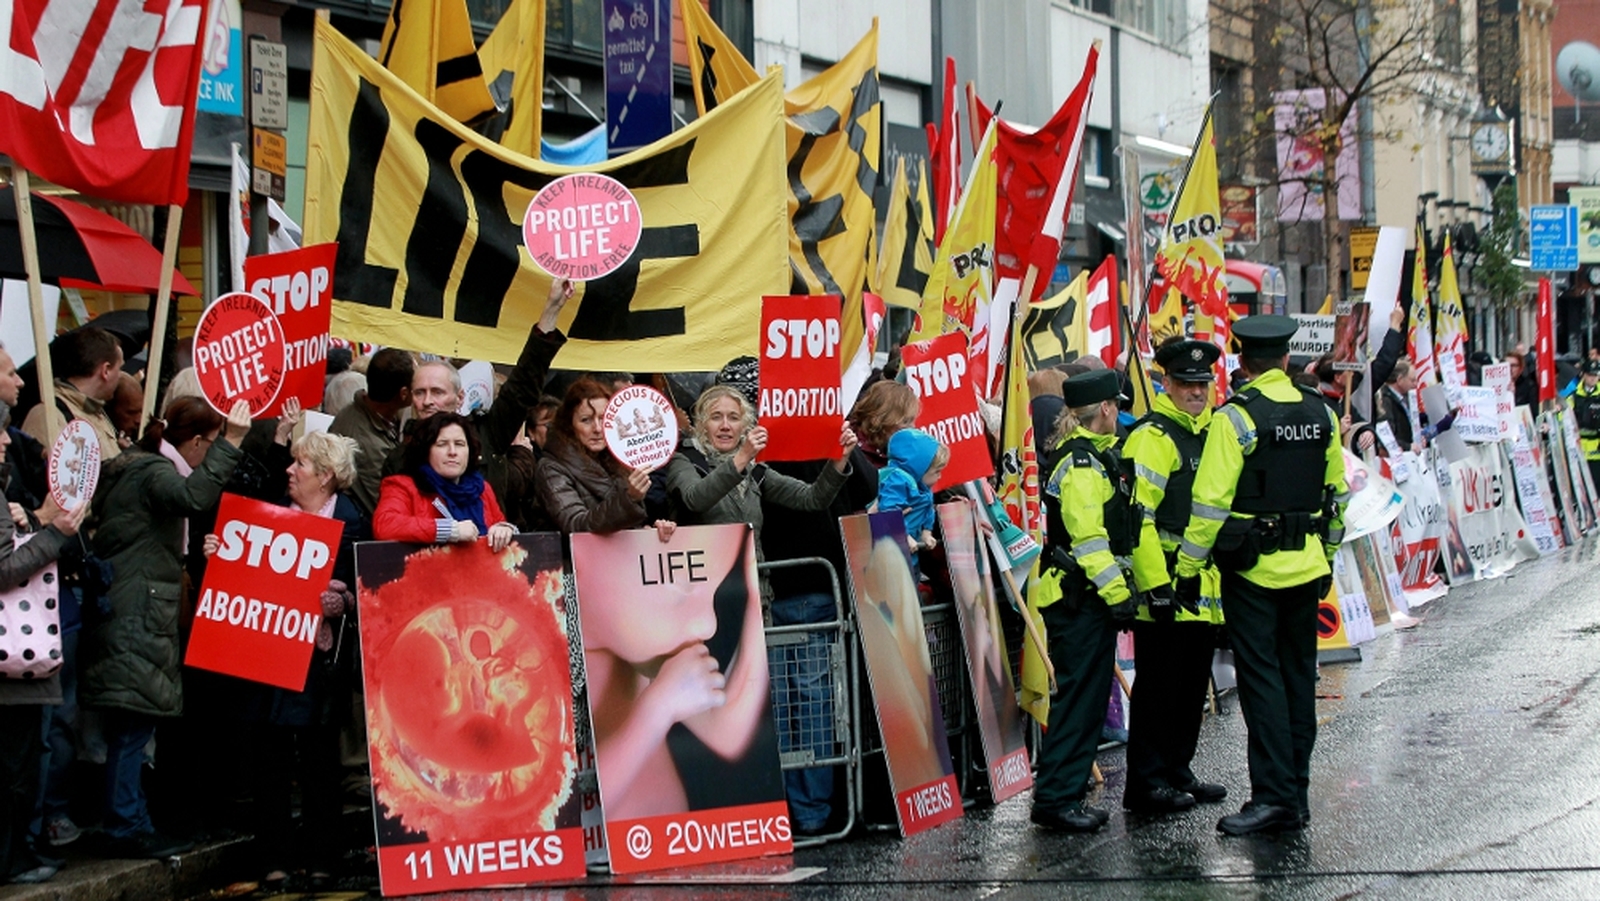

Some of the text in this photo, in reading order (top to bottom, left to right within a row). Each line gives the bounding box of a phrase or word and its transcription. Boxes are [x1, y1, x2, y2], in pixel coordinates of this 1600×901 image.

[608, 37, 645, 57] permitted
[620, 58, 635, 74] taxi
[215, 81, 235, 103] INK
[335, 77, 699, 341] LIFE
[535, 176, 627, 208] KEEP IRELAND
[530, 200, 633, 234] PROTECT
[537, 243, 631, 278] ABORTION-FREE
[554, 227, 612, 260] LIFE
[251, 267, 329, 315] STOP
[198, 296, 266, 342] KEEP IRELAND
[766, 319, 840, 358] STOP
[197, 316, 275, 374] PROTECT
[284, 332, 328, 372] RTION
[220, 352, 269, 399] LIFE
[905, 353, 966, 399] STOP
[605, 388, 672, 430] PRECIOUS LIFE
[919, 411, 984, 445] ORTION
[627, 430, 664, 447] Abortion?
[1275, 424, 1321, 441] POLICE
[51, 422, 80, 506] PRECIOUS LIFE
[216, 519, 330, 580] STOP
[639, 549, 708, 586] LIFE
[196, 588, 319, 644] ABORTION
[905, 781, 953, 822] 7 WEEKS
[404, 851, 435, 881] 11
[443, 834, 564, 876] WEEKS
[626, 823, 653, 860] @
